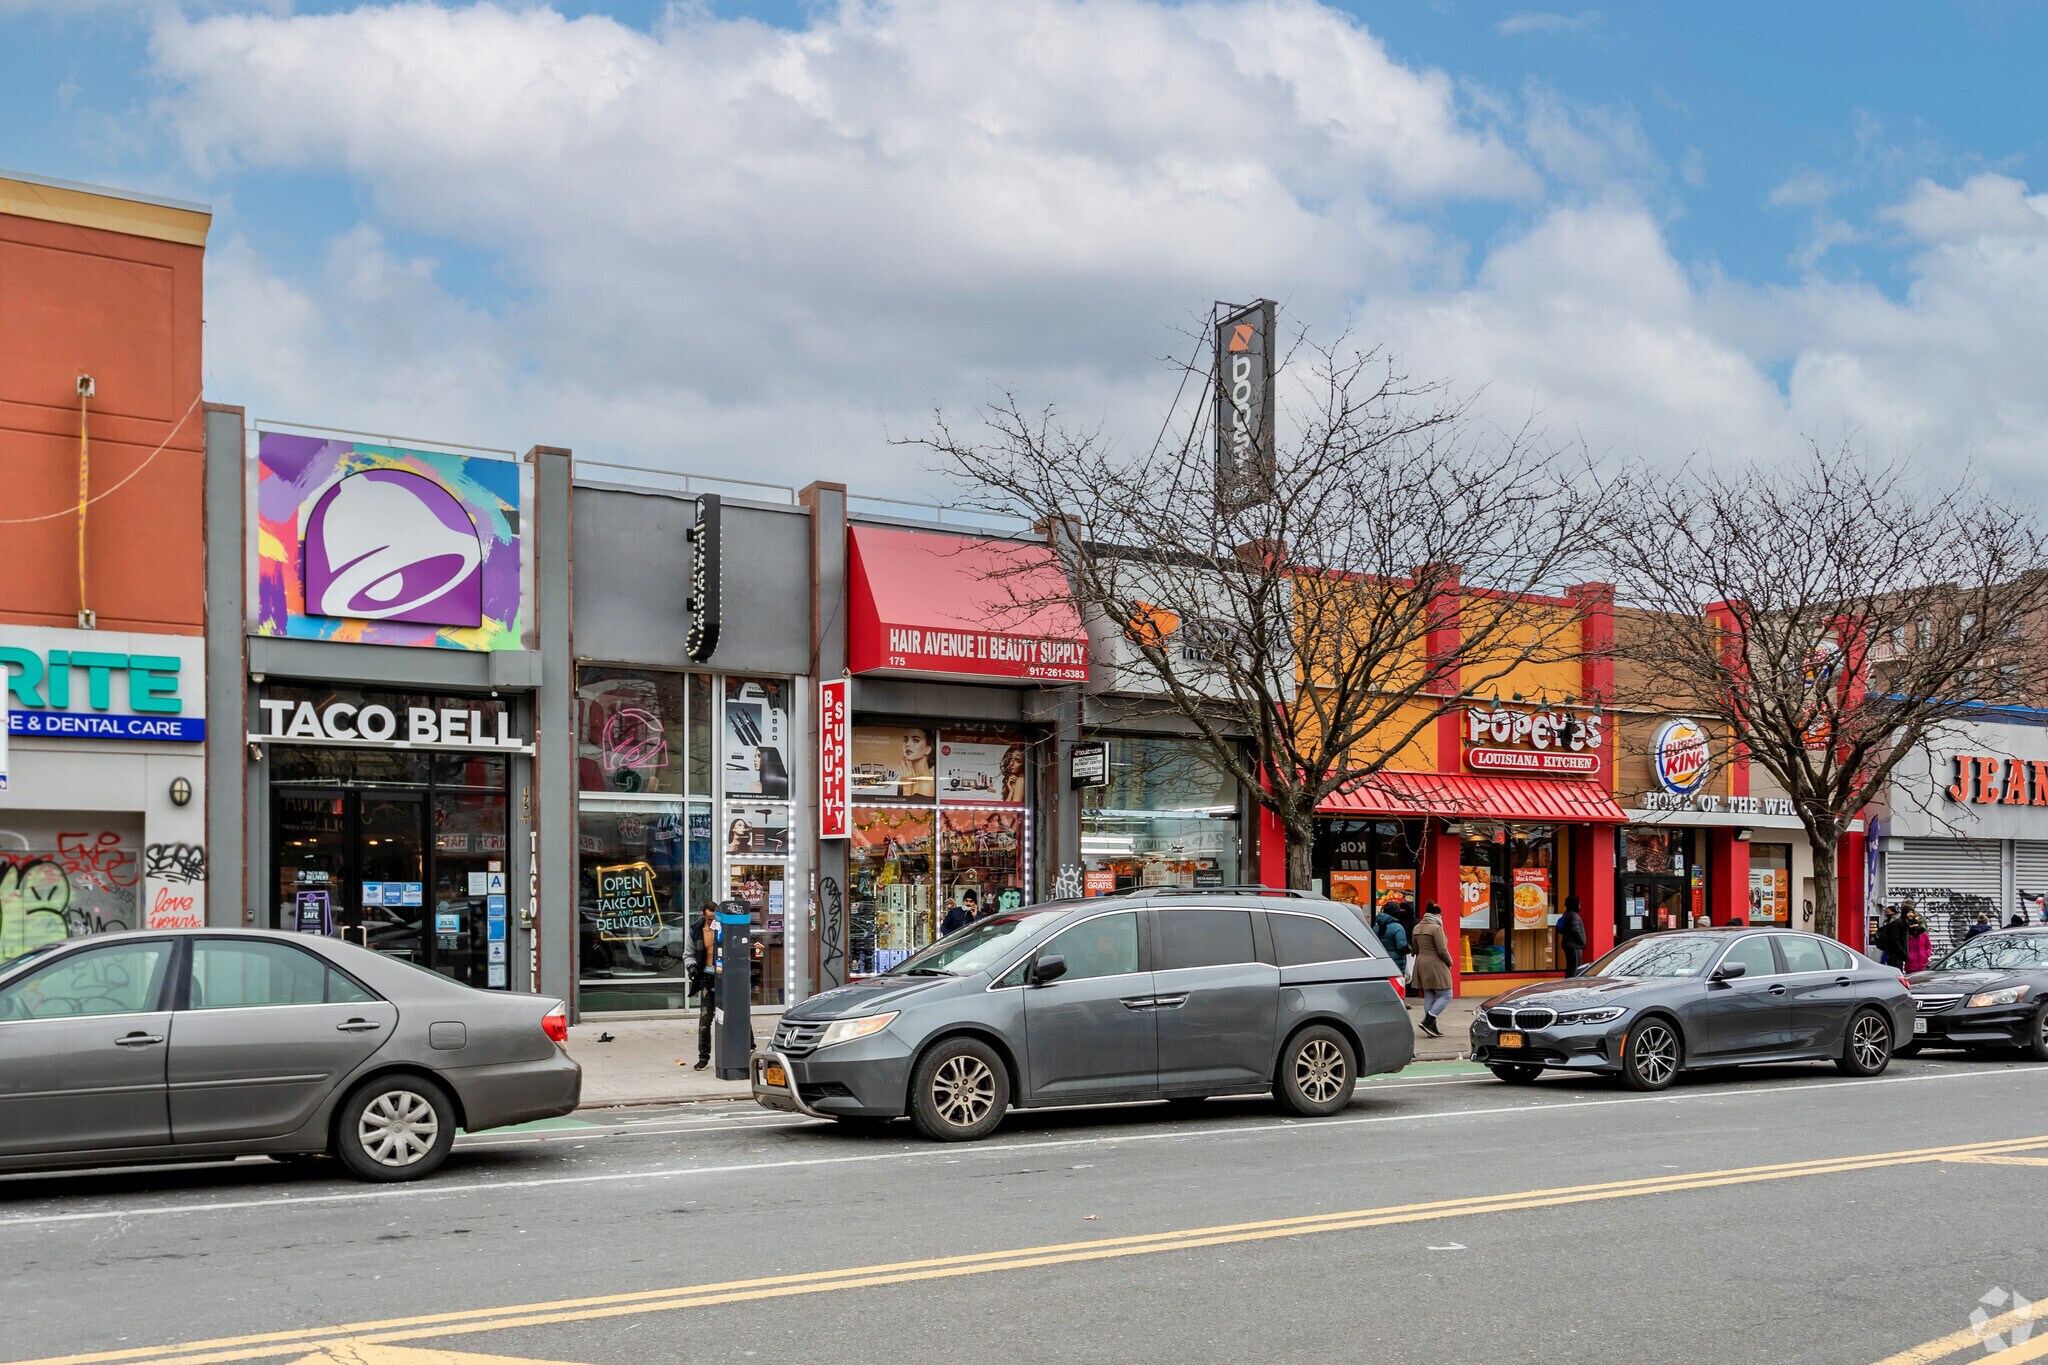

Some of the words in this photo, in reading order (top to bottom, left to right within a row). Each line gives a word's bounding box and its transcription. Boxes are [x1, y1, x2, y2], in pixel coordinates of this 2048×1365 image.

[889, 628, 921, 654] HAIR
[924, 632, 974, 657] AVENUE
[990, 637, 1036, 662] BEAUTY
[1040, 641, 1084, 664] SUPPLY
[888, 657, 906, 666] 175
[1029, 667, 1085, 679] 917-261-5383
[27, 716, 41, 731] &
[46, 717, 125, 734] DENTAL
[128, 720, 182, 736] CARE
[260, 699, 396, 741] TACO
[408, 706, 523, 748] BELL
[824, 690, 834, 816] BEAUTY
[1665, 736, 1703, 759] BURGER
[834, 701, 845, 829] SUPPLY
[1478, 752, 1539, 767] LOUISIANA
[1544, 756, 1593, 769] KITCHEN
[1665, 750, 1704, 777] KING
[1646, 792, 1693, 811] HOME
[1701, 794, 1720, 812] OF
[1728, 796, 1759, 814] THE
[491, 875, 502, 888] A
[604, 876, 642, 891] OPEN
[1087, 881, 1113, 890] GRATIS
[1379, 873, 1411, 881] Cajun-style
[1385, 880, 1405, 889] Turkey
[150, 886, 194, 915] love
[596, 895, 653, 911] TAKEOUT
[618, 909, 634, 917] AND
[596, 914, 655, 931] DELIVERY
